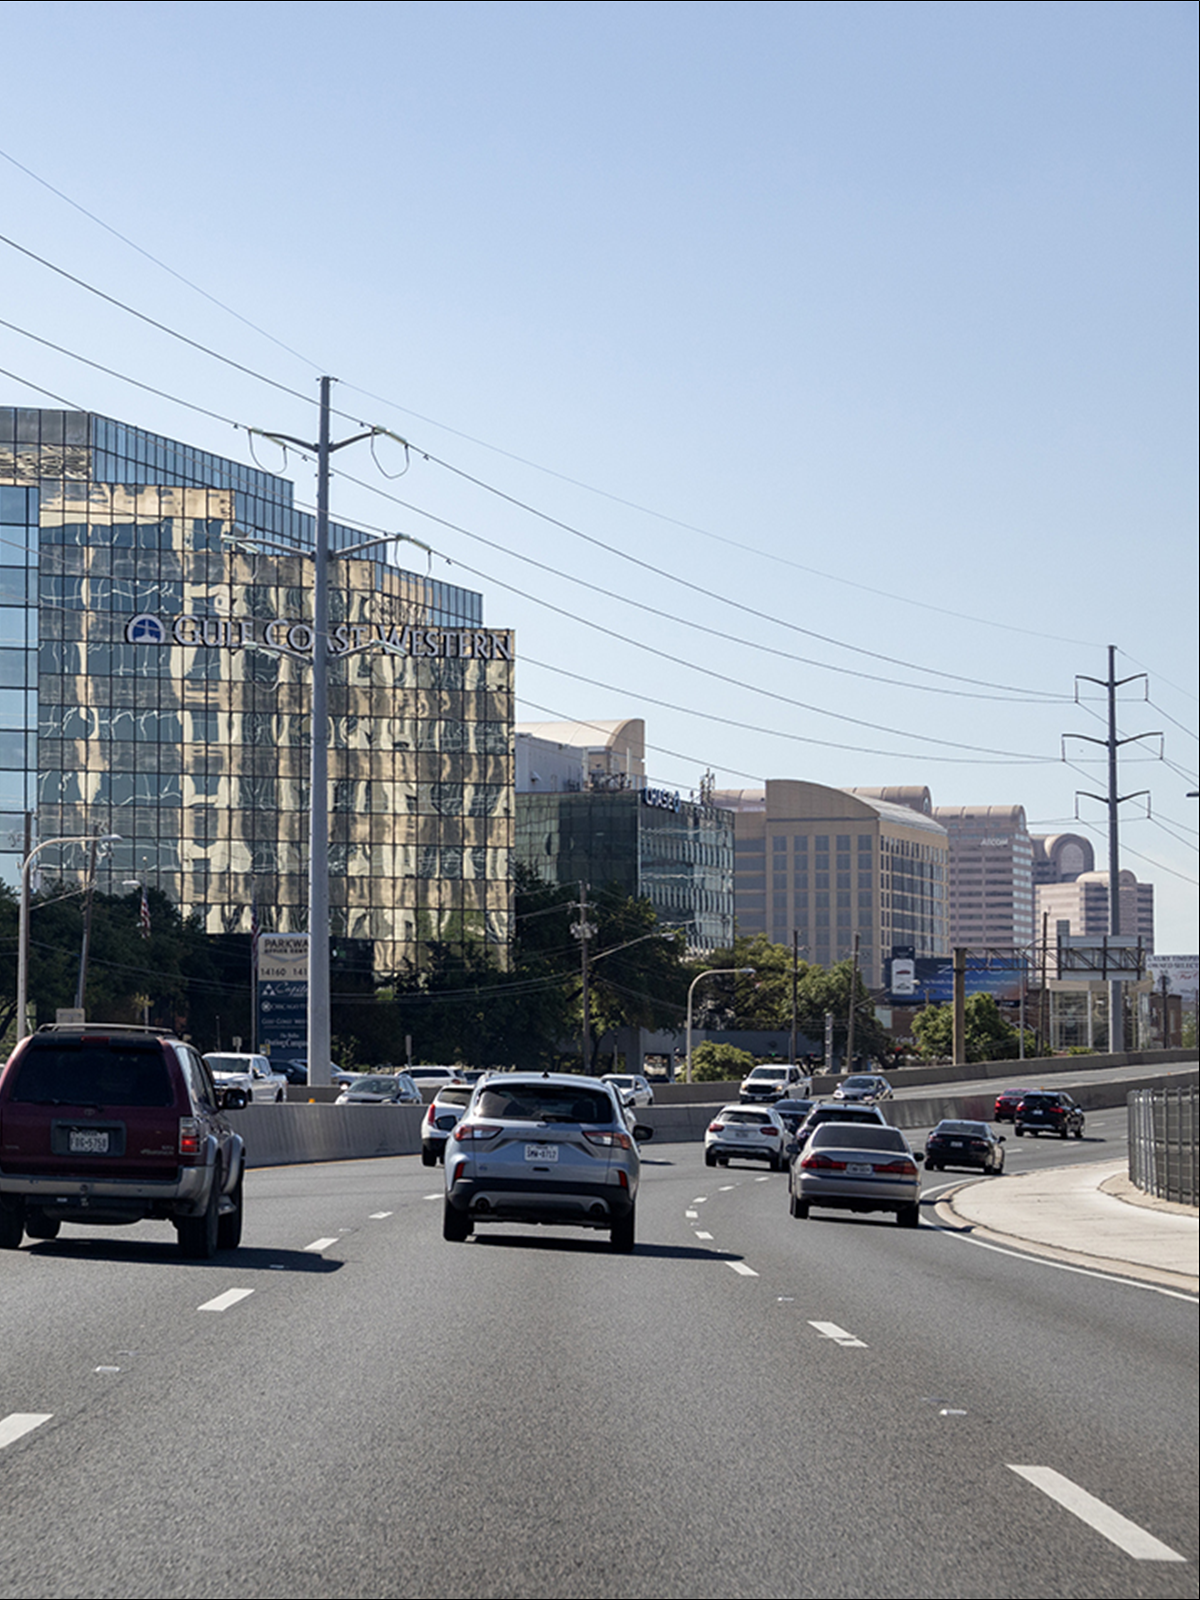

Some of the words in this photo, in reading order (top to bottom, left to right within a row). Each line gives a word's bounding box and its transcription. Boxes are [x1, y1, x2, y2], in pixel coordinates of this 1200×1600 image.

[172, 615, 253, 648] GULF
[376, 624, 512, 660] WESTERN
[264, 938, 308, 948] PARKWA
[260, 967, 287, 976] 14160
[293, 967, 308, 976] 141
